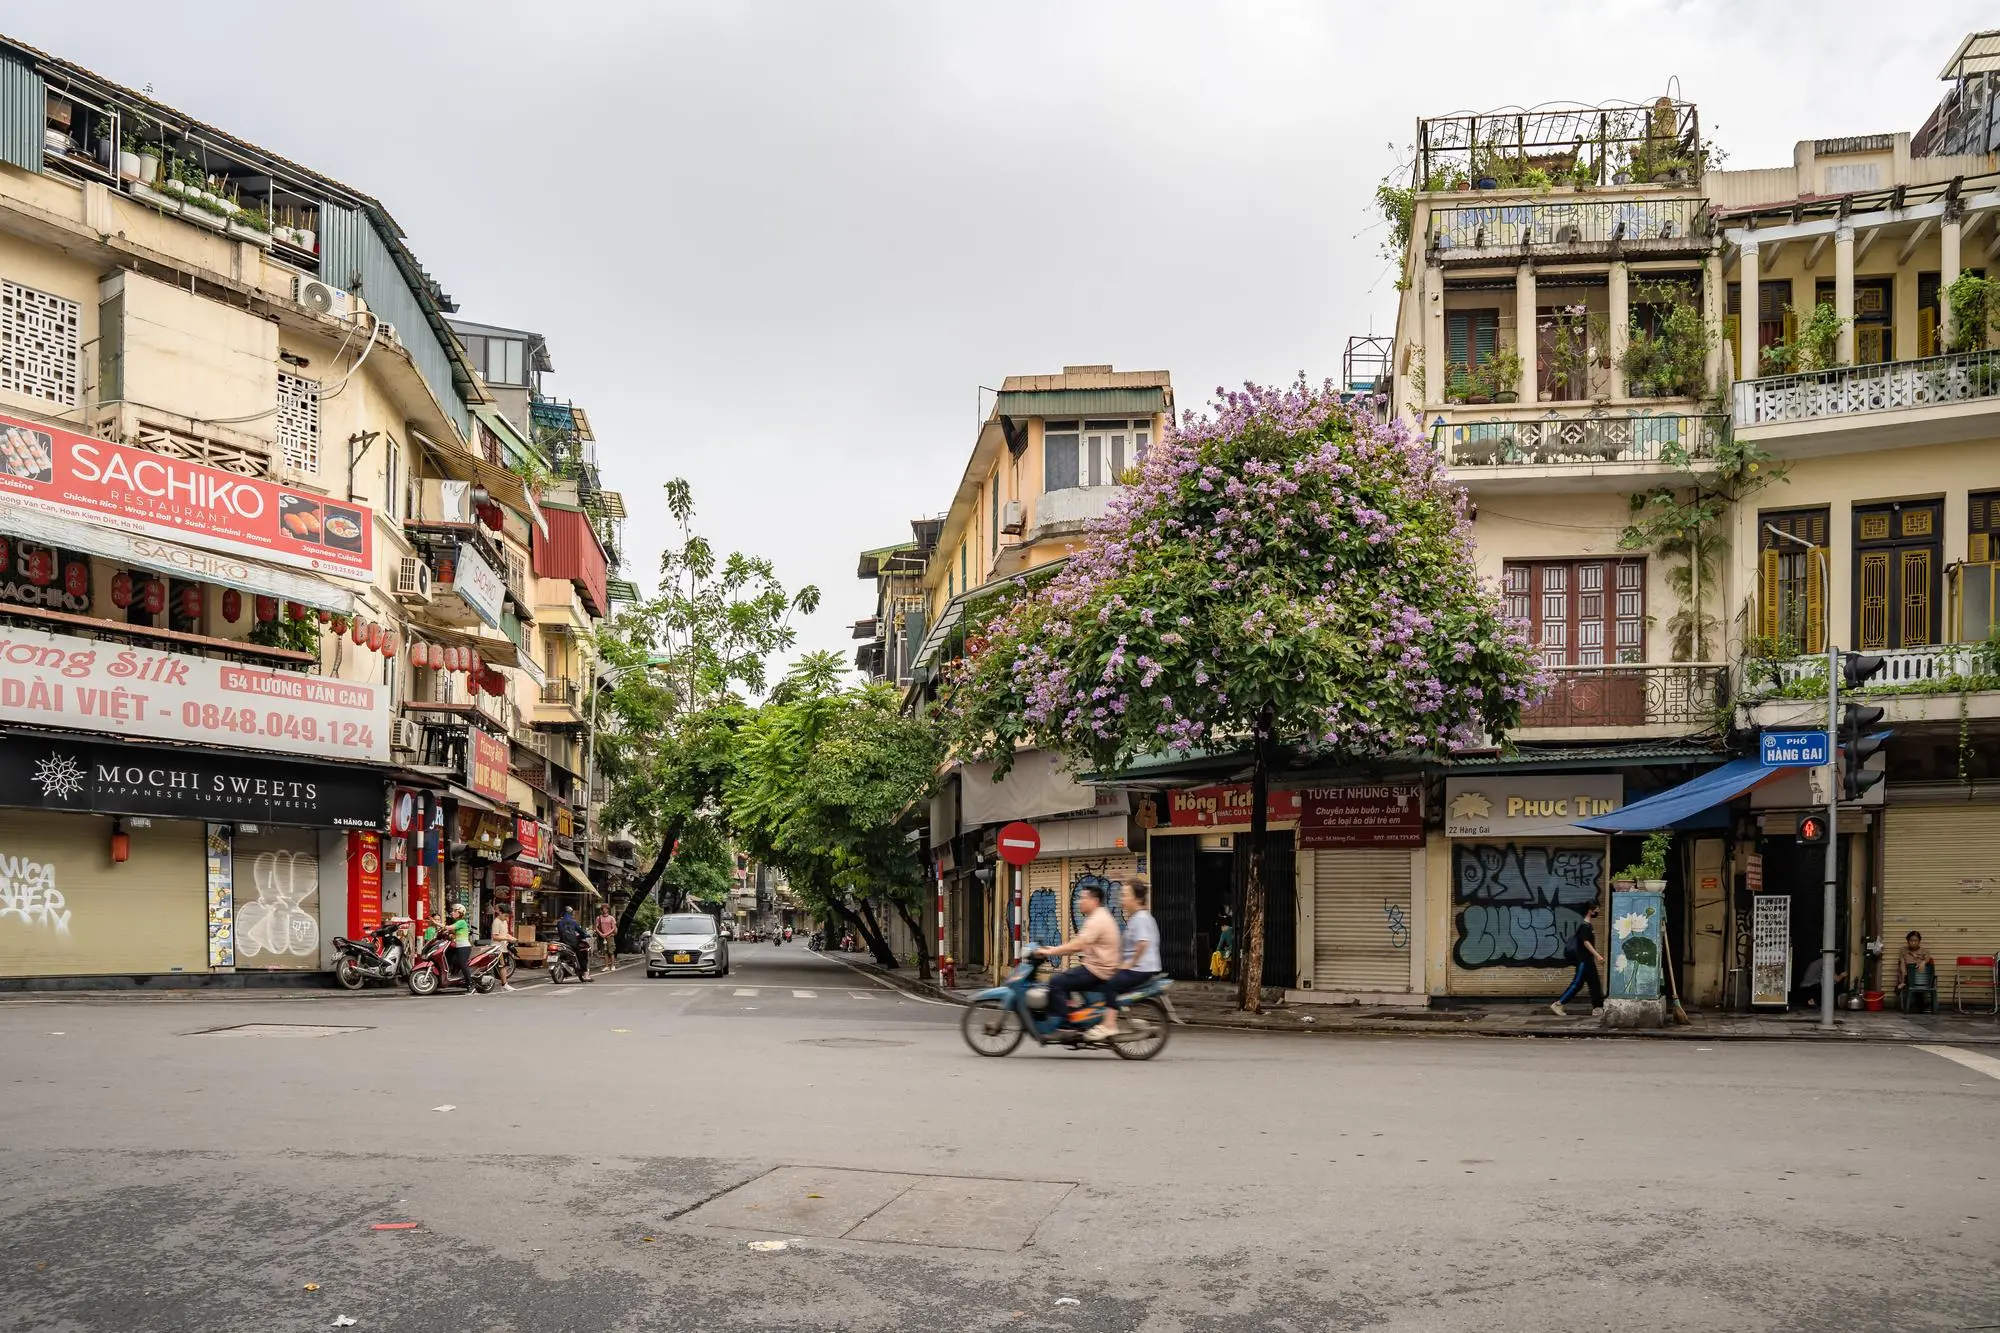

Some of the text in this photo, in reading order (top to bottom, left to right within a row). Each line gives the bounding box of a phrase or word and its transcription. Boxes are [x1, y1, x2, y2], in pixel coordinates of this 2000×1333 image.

[0, 477, 34, 491] Cuisine
[71, 444, 264, 518] SACHIKO
[23, 499, 39, 508] Van
[40, 503, 58, 513] Can,
[60, 507, 80, 517] Hoan
[81, 512, 101, 521] Kiem
[121, 520, 131, 528] Ha
[132, 522, 145, 531] Noi
[63, 492, 98, 505] Chicken
[100, 500, 118, 509] Rice
[124, 506, 147, 516] Wrap
[156, 513, 172, 521] Roll
[184, 519, 206, 528] Sushi
[211, 525, 241, 536] Sashimi
[246, 533, 272, 543] Ramen
[111, 490, 228, 525] RESTAURANT
[133, 541, 248, 579] SACHIKO
[301, 545, 363, 563] Japanese Cuisine
[0, 581, 89, 611] ACHIKO
[106, 651, 190, 686] Silk
[228, 673, 368, 707] 54 LƯƠNG VĂN CAN
[2, 675, 64, 712] DÀI
[75, 686, 149, 725] VIỆT
[183, 701, 374, 749] 0848.049.124
[1786, 735, 1808, 744] PHỐ
[1767, 746, 1823, 762] HÀNG GAI
[97, 764, 317, 799] MOCHI SWEETS
[97, 786, 317, 810] JAPANESE LUXURY SWEETS
[1174, 791, 1217, 813] Hồng
[1347, 788, 1389, 799] NHUNG
[1316, 807, 1344, 816] Chuyên
[1507, 797, 1568, 817] PHUC
[363, 819, 376, 827] GAI
[1323, 817, 1337, 825] các
[1448, 826, 1458, 834] 22
[1479, 825, 1490, 834] Gai
